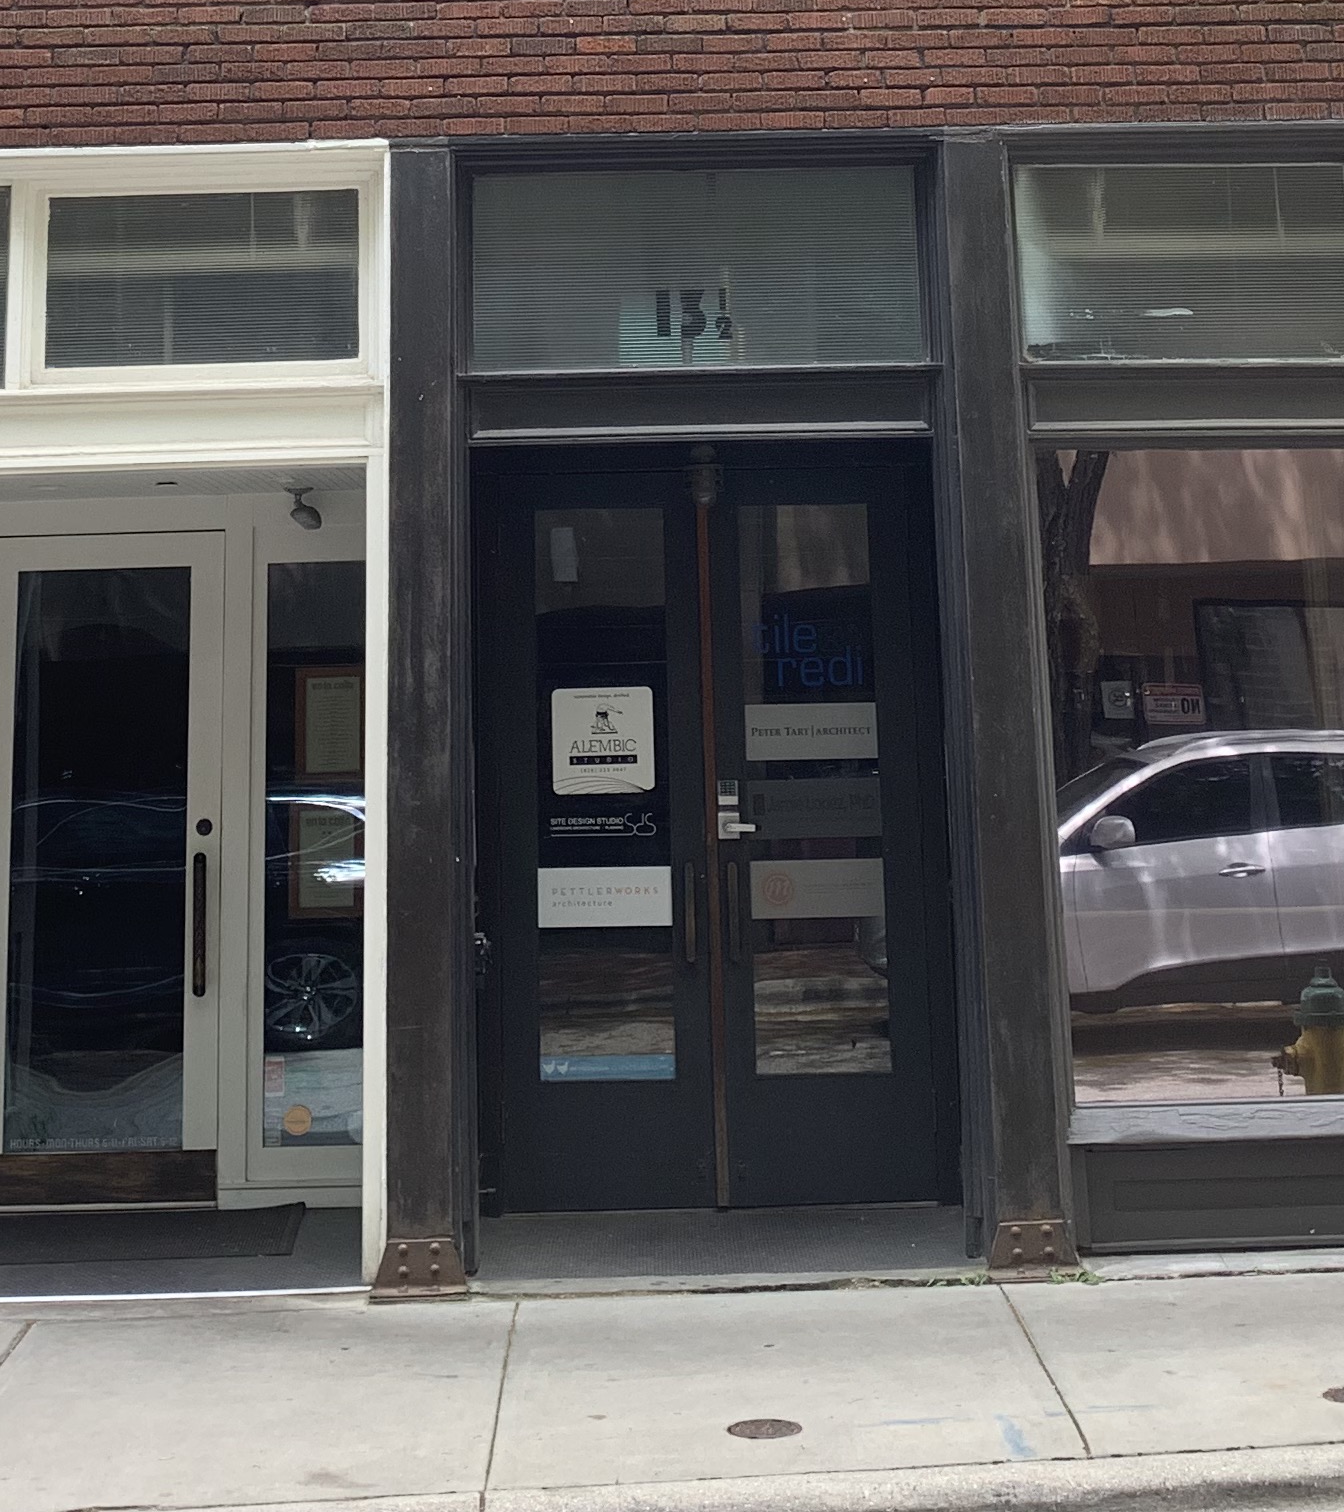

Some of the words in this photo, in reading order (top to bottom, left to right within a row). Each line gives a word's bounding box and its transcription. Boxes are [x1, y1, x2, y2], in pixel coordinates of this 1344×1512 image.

[752, 613, 817, 654] tile
[776, 645, 864, 688] redi
[751, 726, 782, 737] PETER
[569, 738, 637, 754] ALEMBIC
[572, 756, 634, 765] STUDIO
[550, 817, 566, 826] SITE
[567, 817, 596, 826] DESIGN
[596, 816, 624, 825] STUDIO
[551, 886, 659, 896] PETTLERWORKS
[551, 899, 613, 908] architecture
[9, 1138, 41, 1150] HOURS
